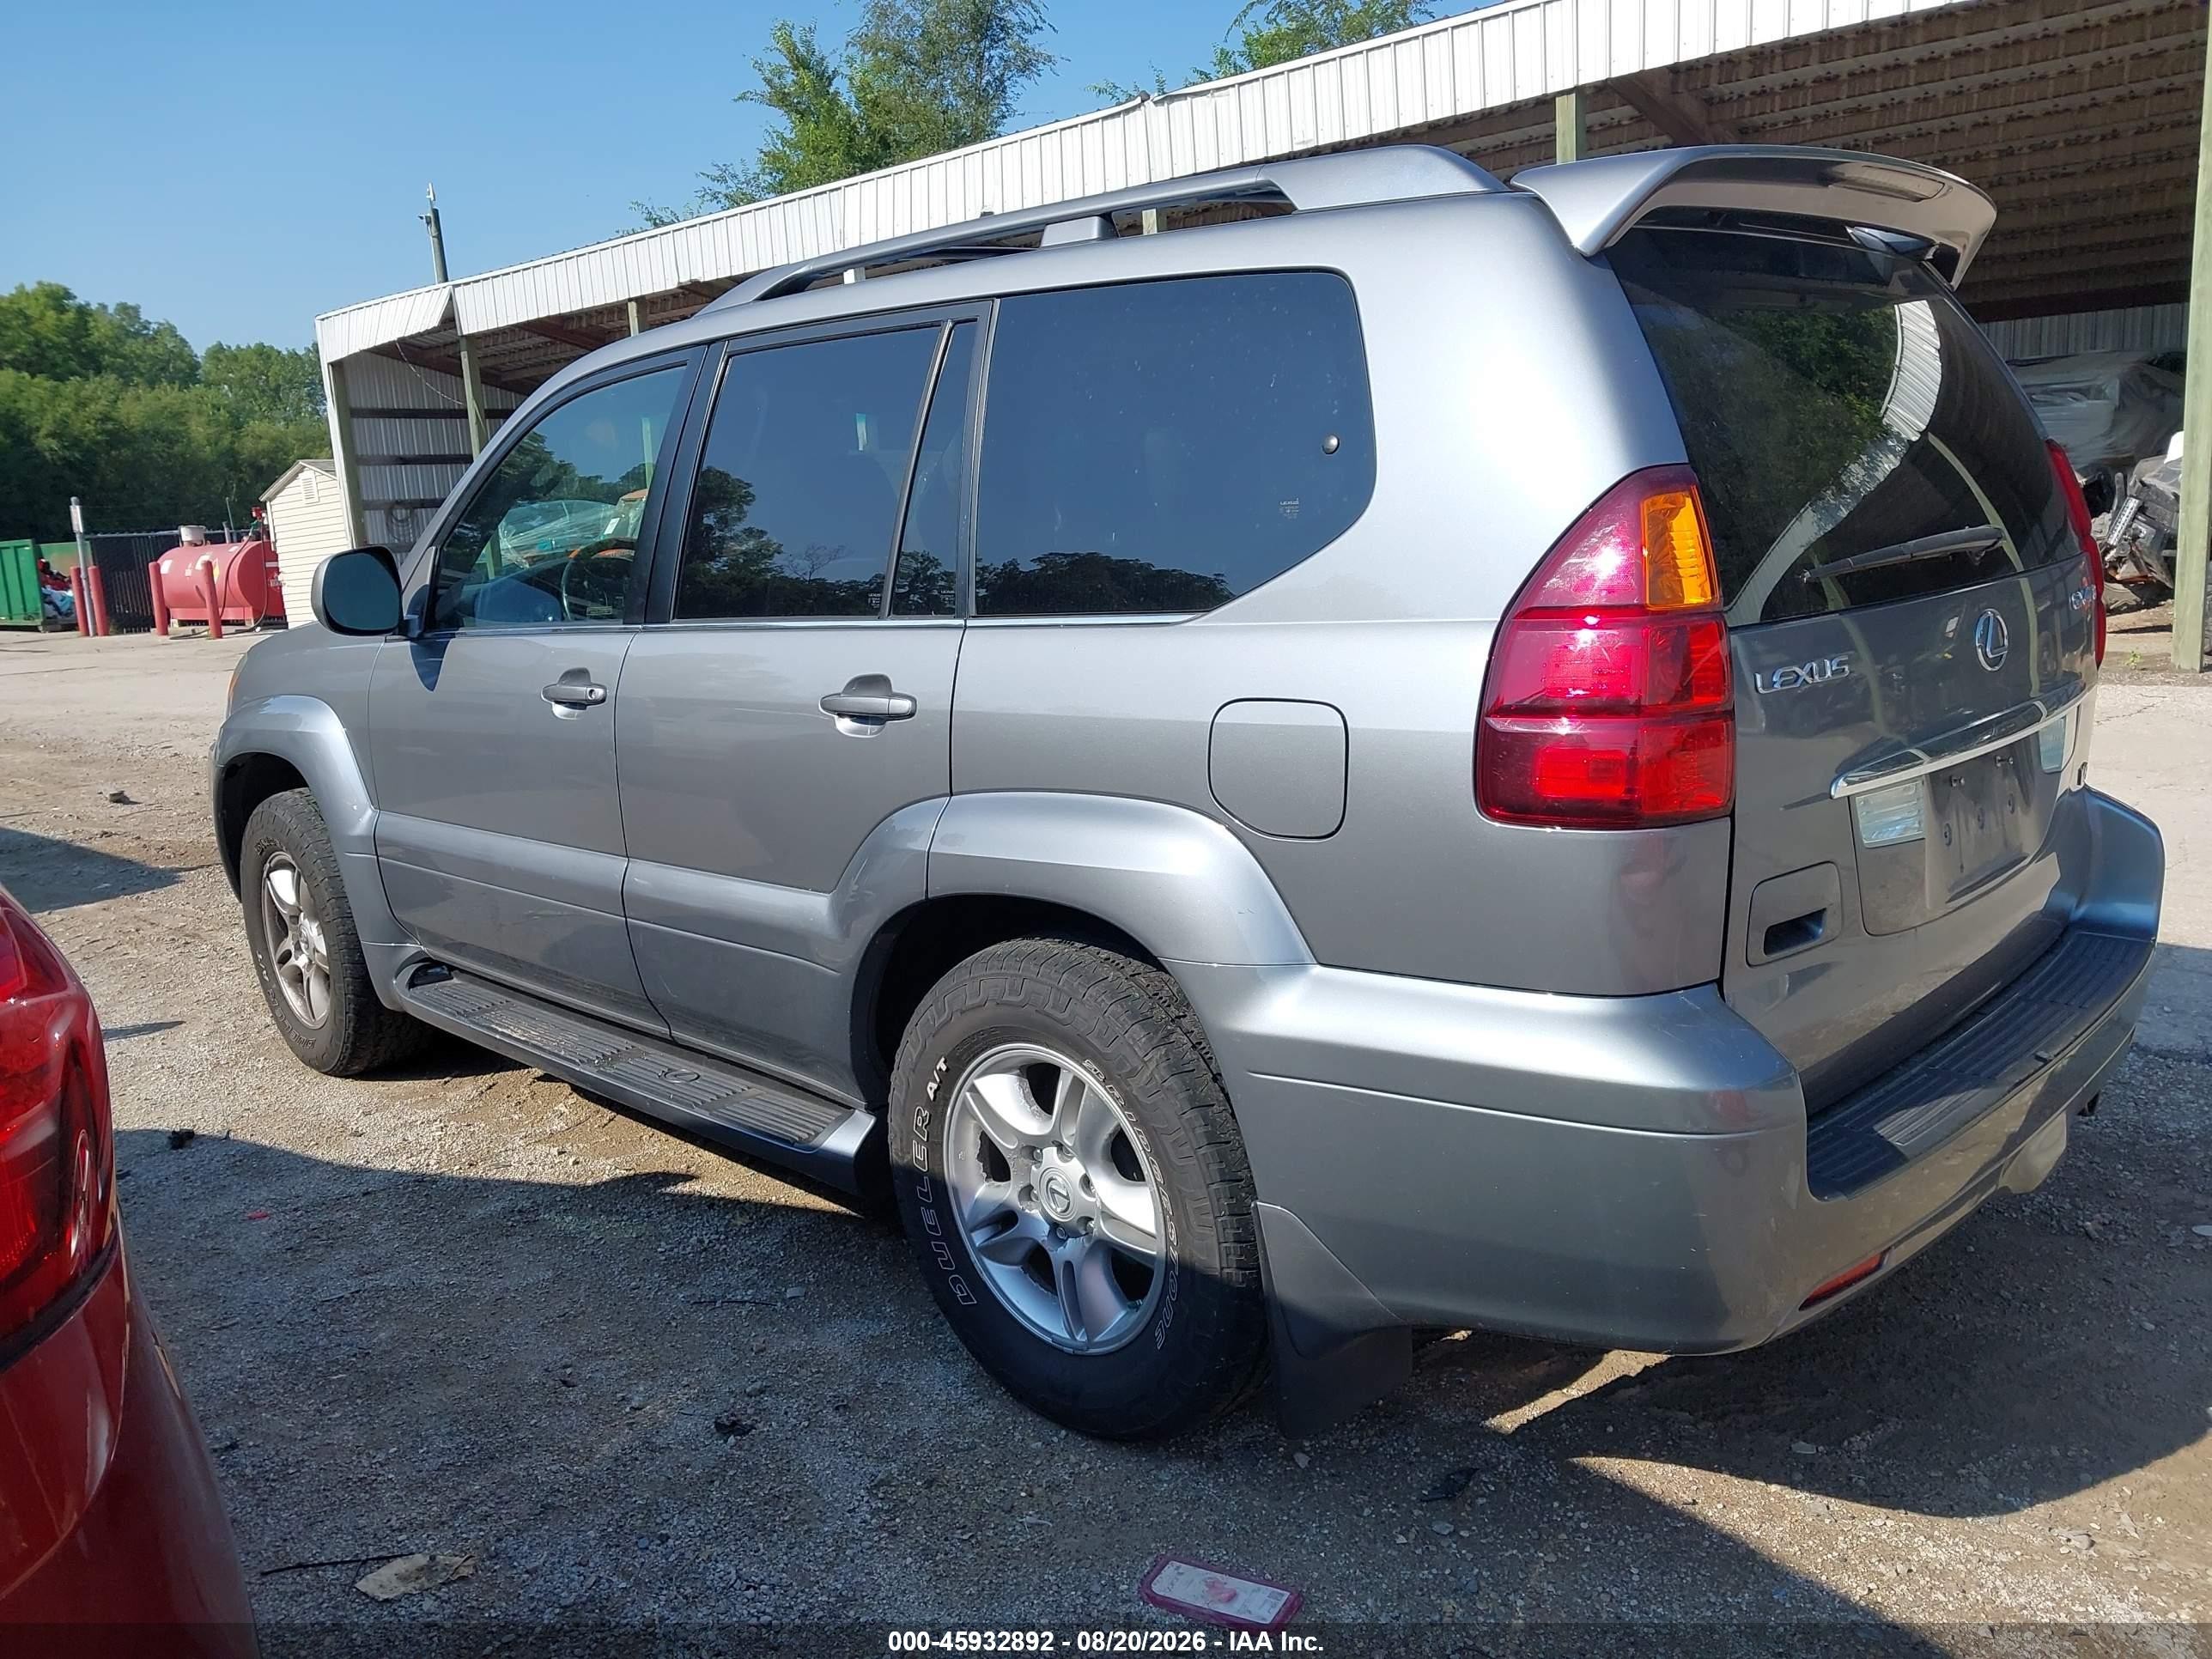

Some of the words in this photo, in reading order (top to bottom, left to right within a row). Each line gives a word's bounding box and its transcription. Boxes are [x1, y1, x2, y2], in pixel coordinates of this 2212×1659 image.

[1754, 654, 1850, 694] LEXUS
[927, 1057, 950, 1101] A/T
[913, 1106, 977, 1305] DUELER
[1082, 1059, 1179, 1350] BRIDGESTONE
